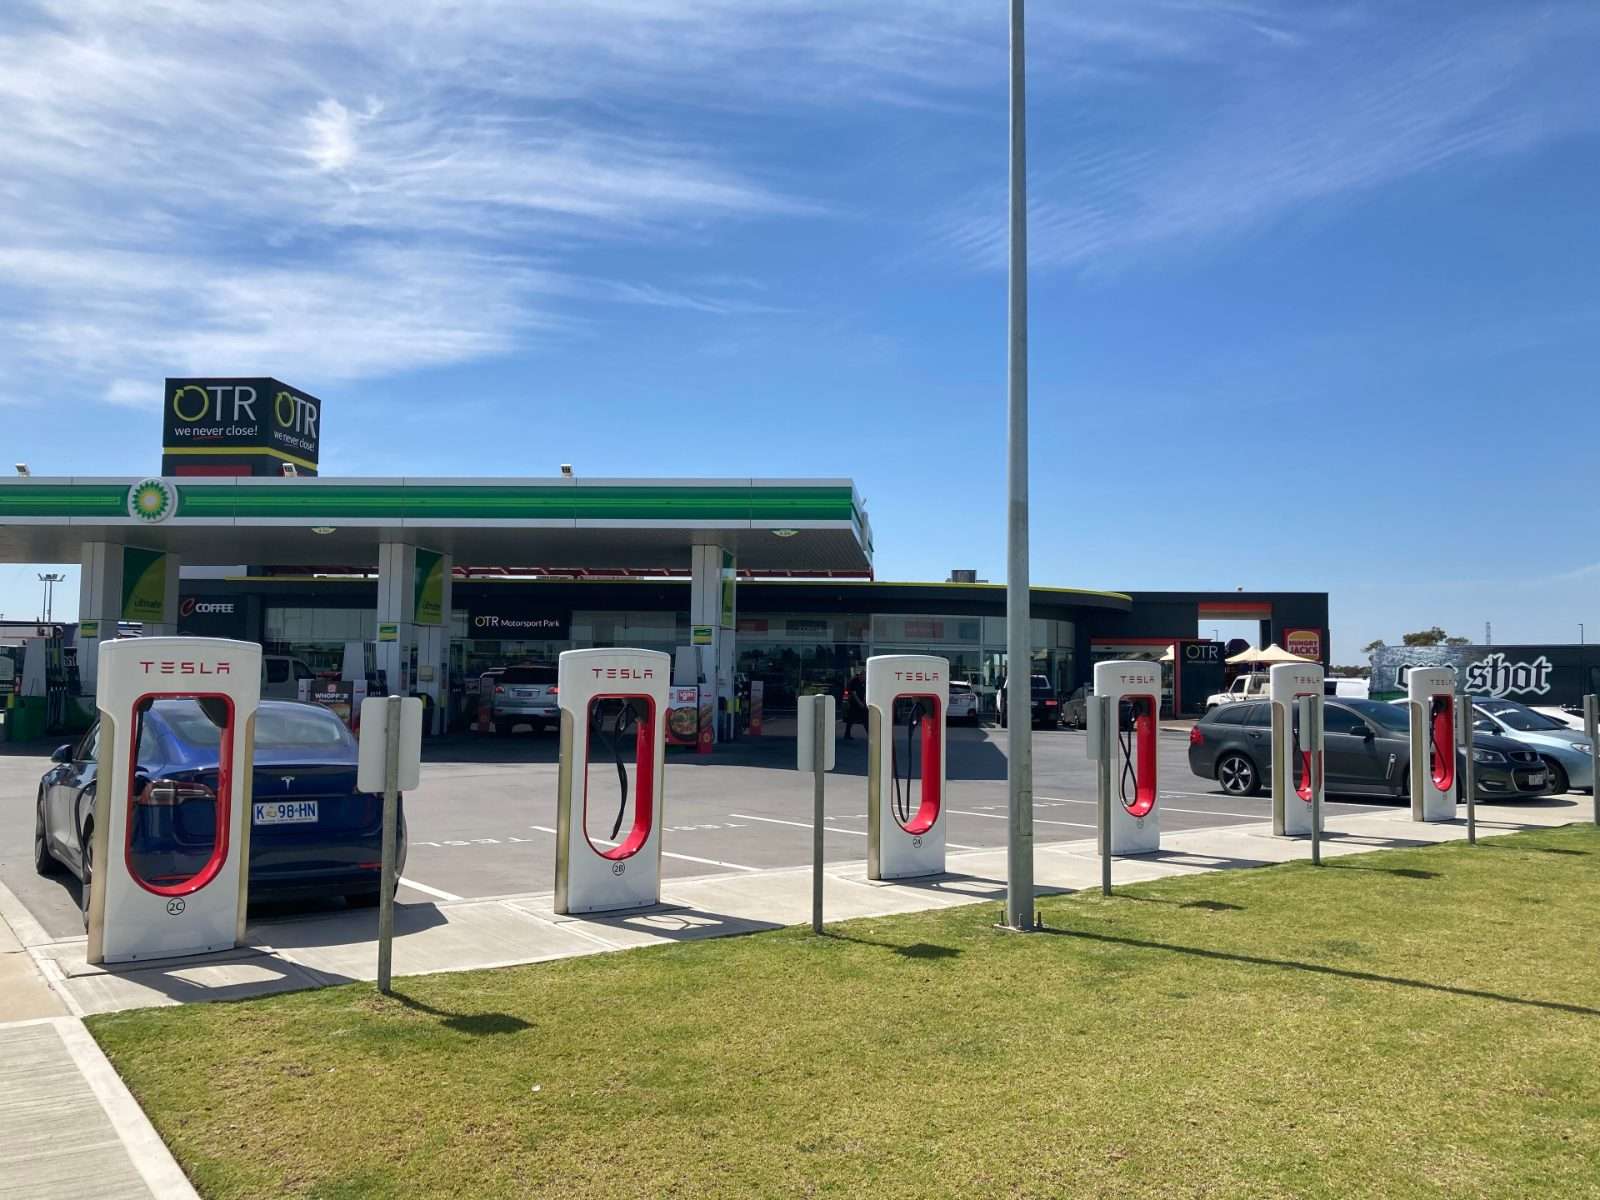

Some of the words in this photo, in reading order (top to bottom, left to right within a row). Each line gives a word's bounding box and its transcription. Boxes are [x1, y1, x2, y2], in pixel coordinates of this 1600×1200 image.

[173, 385, 258, 422] OTR
[274, 391, 317, 439] OTR
[174, 426, 191, 436] we
[192, 426, 223, 436] never
[225, 424, 258, 436] close!
[273, 430, 283, 441] we
[282, 433, 299, 446] never
[299, 437, 315, 452] close!
[195, 603, 235, 613] COFFEE
[475, 616, 499, 627] OTR
[500, 619, 542, 628] Motorsport
[543, 619, 560, 627] Park
[1186, 644, 1218, 659] OTR
[139, 661, 230, 674] TESLA
[591, 668, 653, 679] TESLA
[895, 671, 939, 681] TESLA
[1464, 653, 1552, 698] shot
[256, 806, 264, 820] K
[169, 902, 183, 912] 2C
